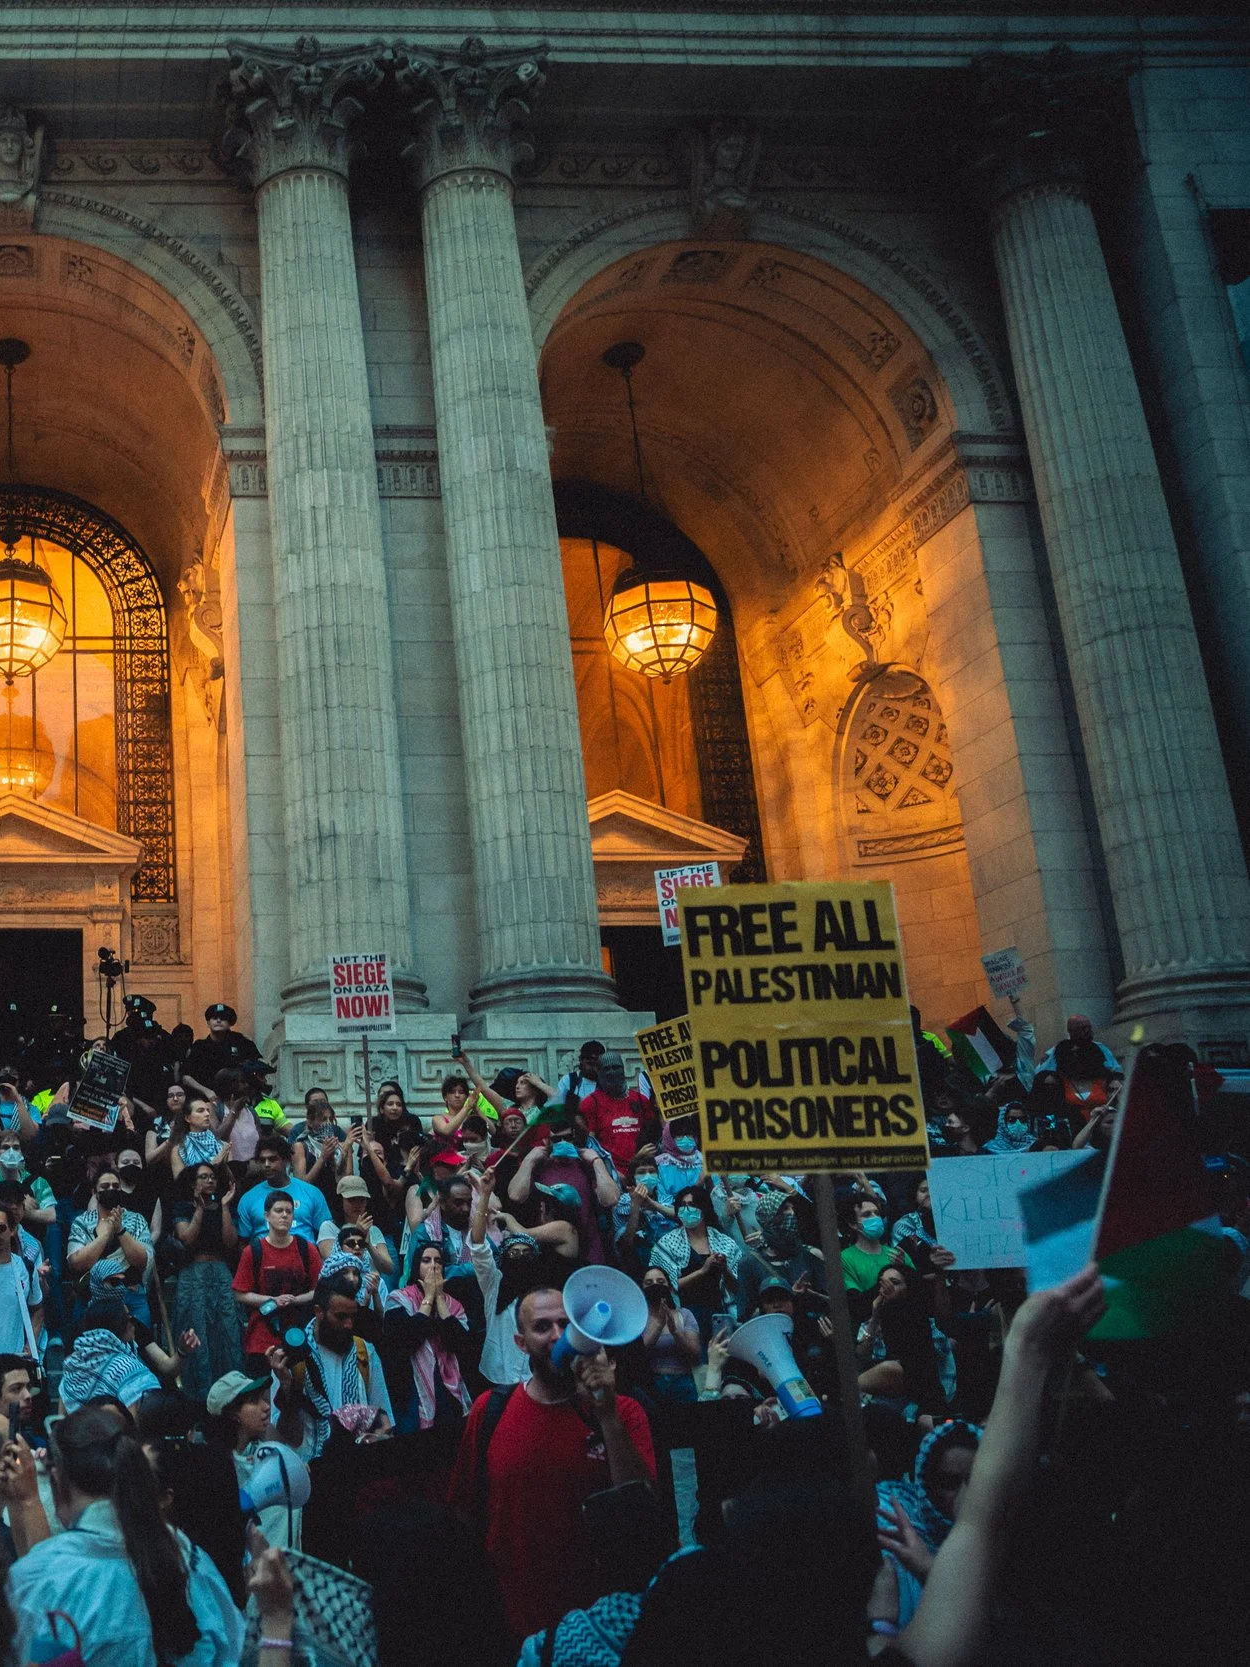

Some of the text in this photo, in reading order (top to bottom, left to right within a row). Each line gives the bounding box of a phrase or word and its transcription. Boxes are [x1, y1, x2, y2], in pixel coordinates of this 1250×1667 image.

[659, 864, 714, 879] LIFT THE
[683, 899, 896, 957] FREE ALL
[332, 954, 386, 964] LIFT THE
[333, 962, 387, 986] SIEGE
[690, 961, 902, 1005] PALESTINIAN
[333, 984, 390, 994] ON GAZA
[336, 994, 390, 1019] NOW!
[638, 1026, 678, 1055] FREE
[645, 1044, 693, 1072] PALESTIN
[699, 1036, 912, 1089] POLITICAL
[660, 1066, 696, 1090] POLITI
[660, 1084, 698, 1108] PRISO
[705, 1094, 918, 1141] PRISONERS
[731, 1157, 761, 1169] Party
[863, 1153, 925, 1165] Liberation
[938, 1196, 1016, 1225] KILL
